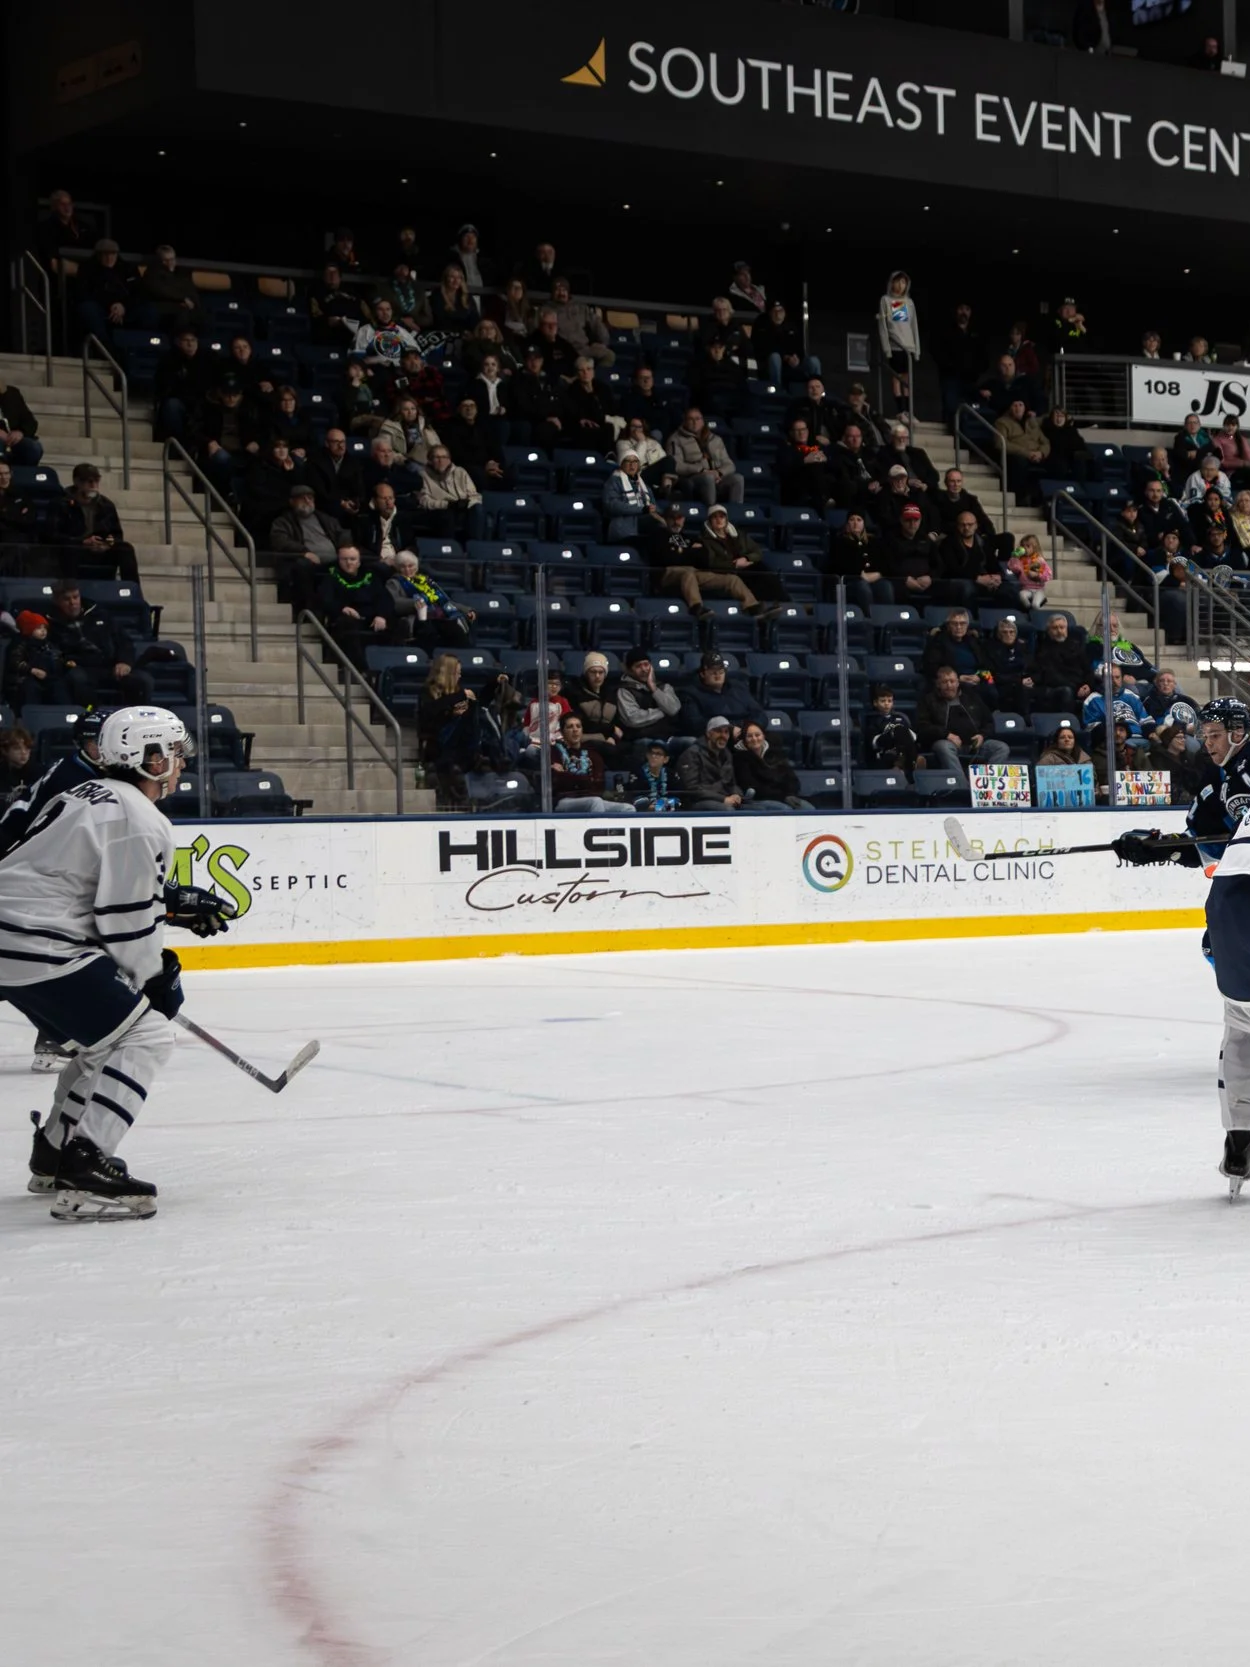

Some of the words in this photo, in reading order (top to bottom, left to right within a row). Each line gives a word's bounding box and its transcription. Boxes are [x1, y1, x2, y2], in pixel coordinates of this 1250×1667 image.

[627, 40, 957, 136] SOUTHEAST
[975, 92, 1132, 160] EVENT
[1144, 379, 1181, 396] 108
[1191, 379, 1250, 417] JS
[975, 776, 1006, 790] CUTS
[1077, 768, 1092, 786] 16
[438, 825, 733, 873] HILLSIDE
[252, 874, 348, 891] SEPTIC
[866, 863, 967, 885] DENTAL
[972, 860, 1055, 882] CLINIC
[465, 867, 711, 912] Custom
